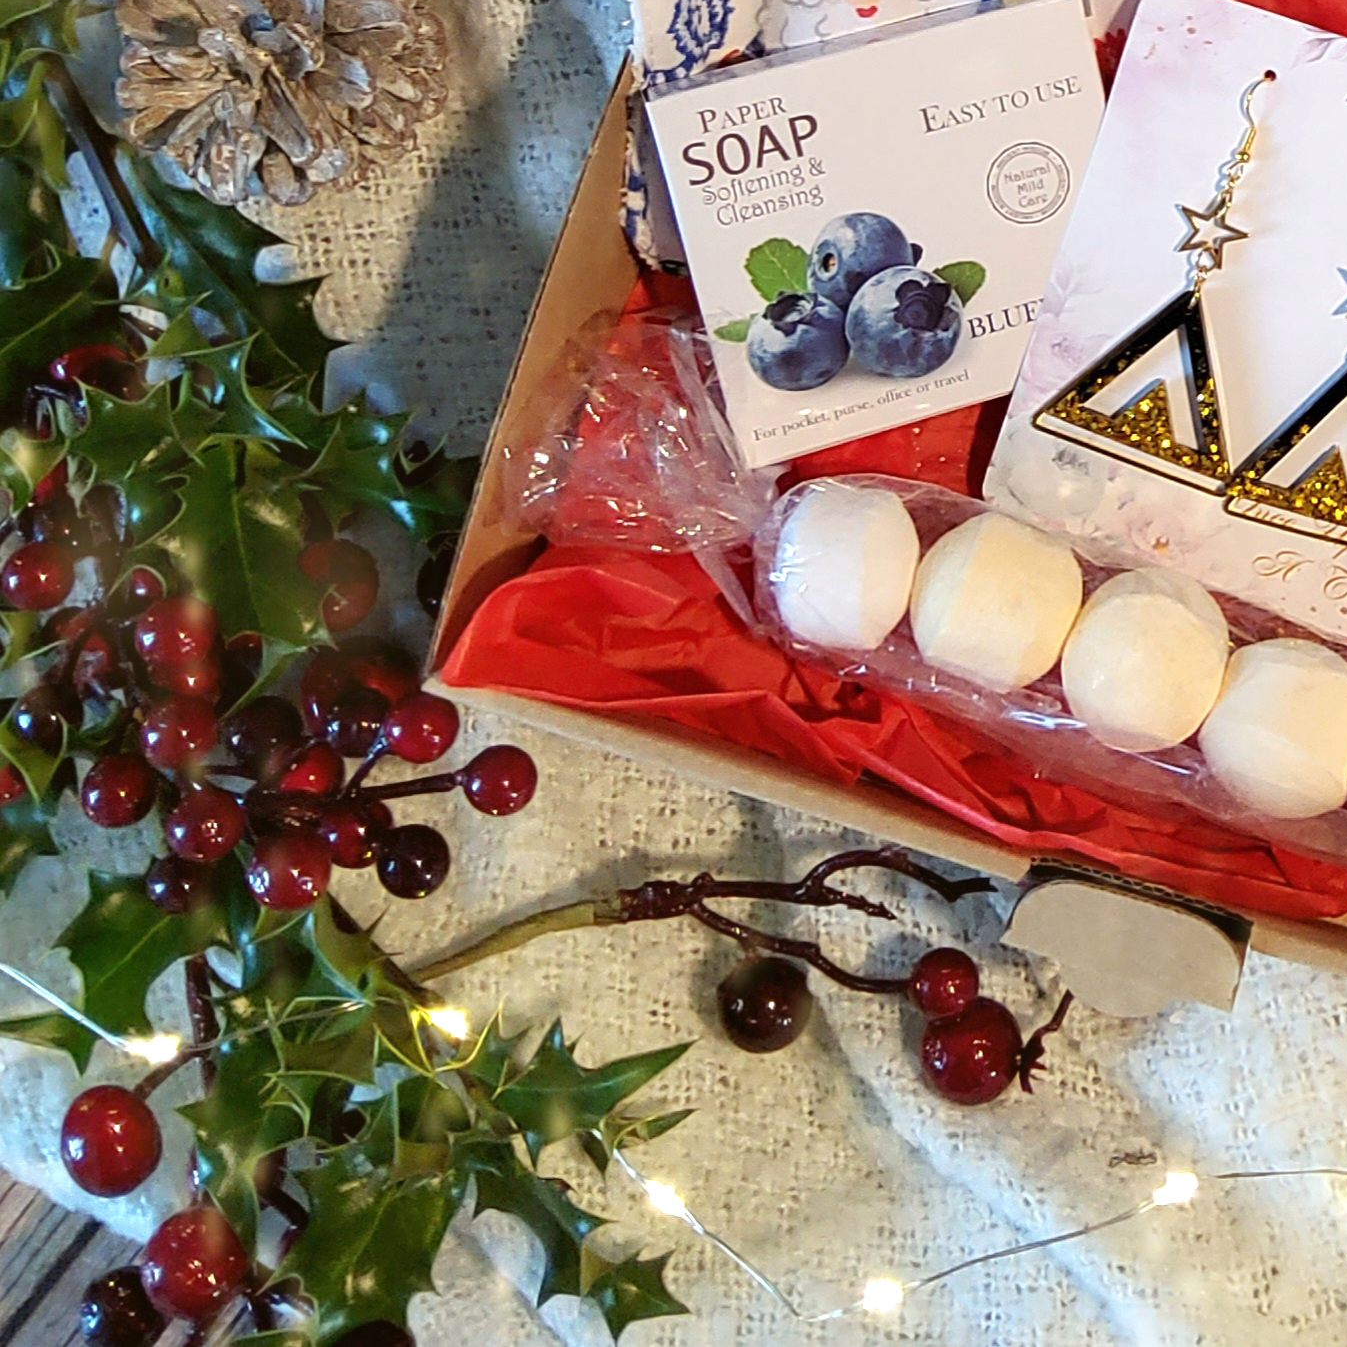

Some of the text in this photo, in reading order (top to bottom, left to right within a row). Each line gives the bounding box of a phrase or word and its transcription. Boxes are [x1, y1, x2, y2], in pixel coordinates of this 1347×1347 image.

[696, 97, 788, 134] PAPER
[918, 75, 1082, 134] EASY TO USE
[682, 114, 818, 186] SOAP
[702, 156, 827, 206] Softening &
[1003, 162, 1051, 184] Natural
[1017, 178, 1045, 195] Mild
[716, 184, 825, 226] Cleansing
[1018, 193, 1048, 208] Care
[967, 297, 1045, 339] BLUE
[752, 426, 778, 441] For
[876, 387, 912, 404] office
[916, 383, 931, 394] or
[934, 368, 970, 388] travel
